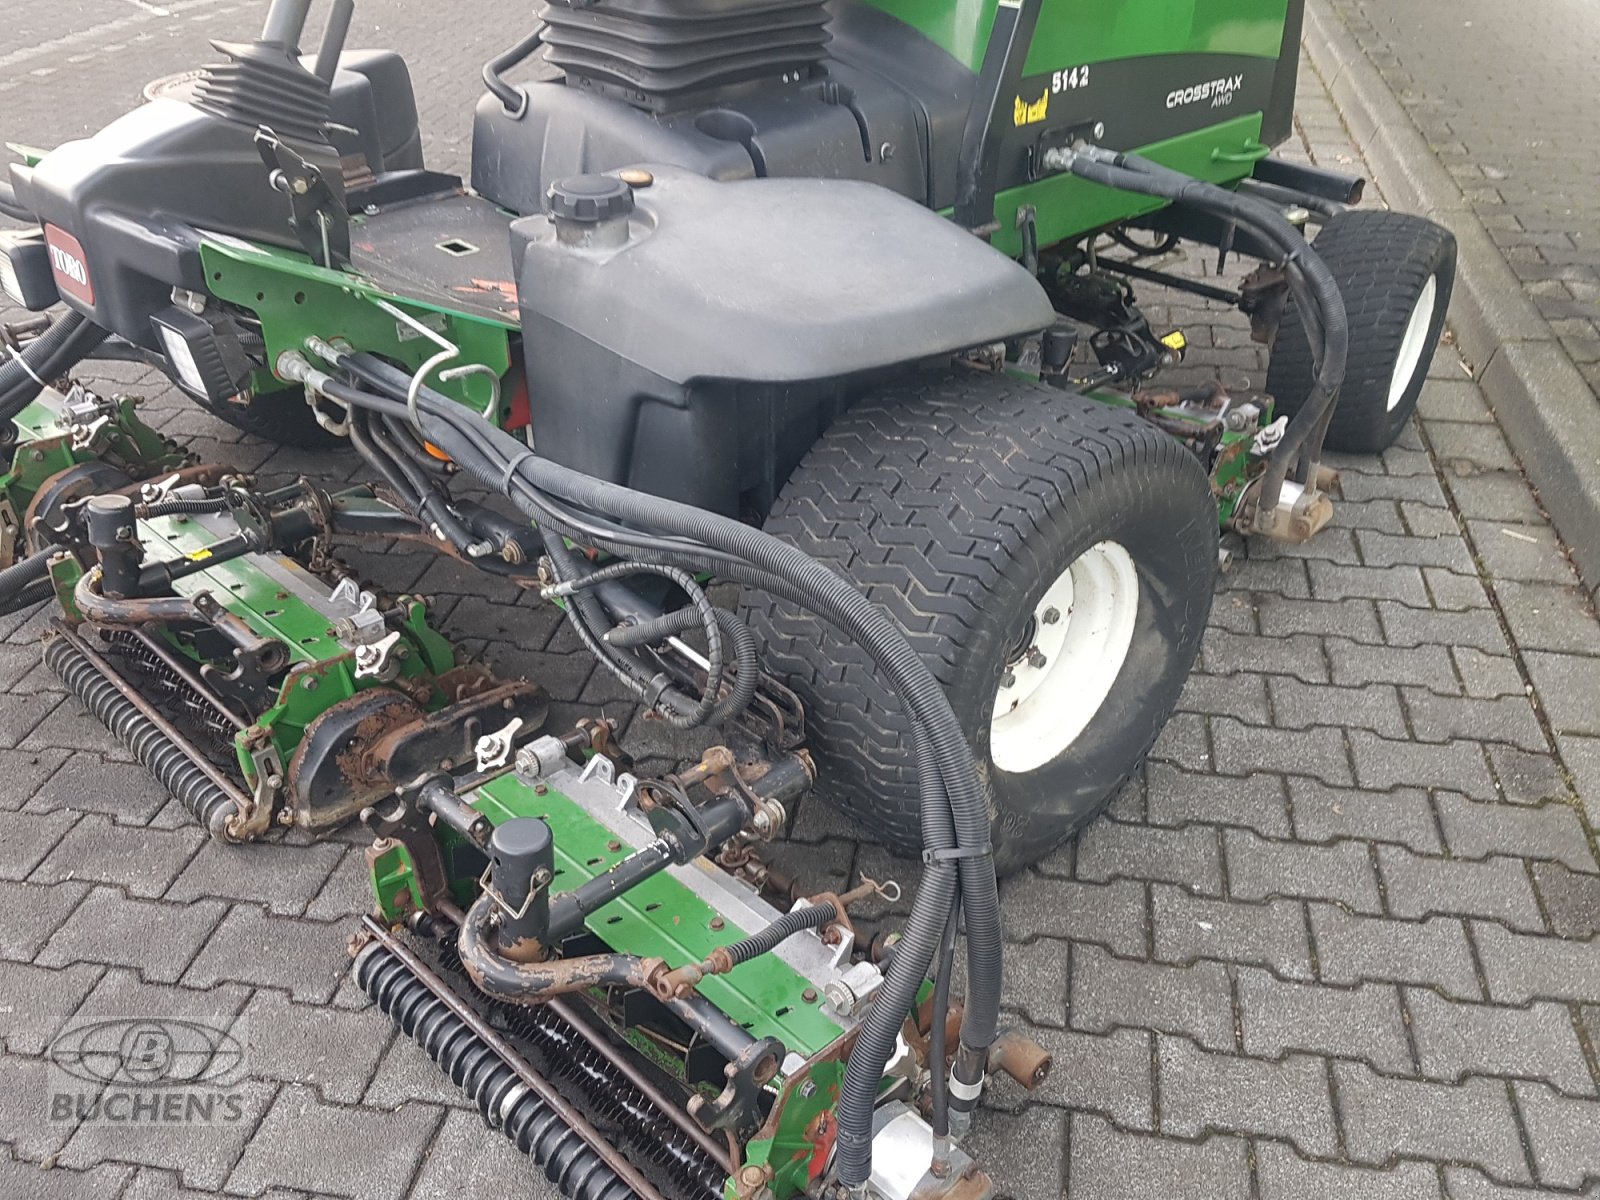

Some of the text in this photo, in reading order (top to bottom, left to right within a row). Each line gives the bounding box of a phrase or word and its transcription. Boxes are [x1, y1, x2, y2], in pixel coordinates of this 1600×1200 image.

[1052, 64, 1089, 94] 5142
[1166, 73, 1243, 109] CROSSTRAX
[49, 243, 87, 286] TORO
